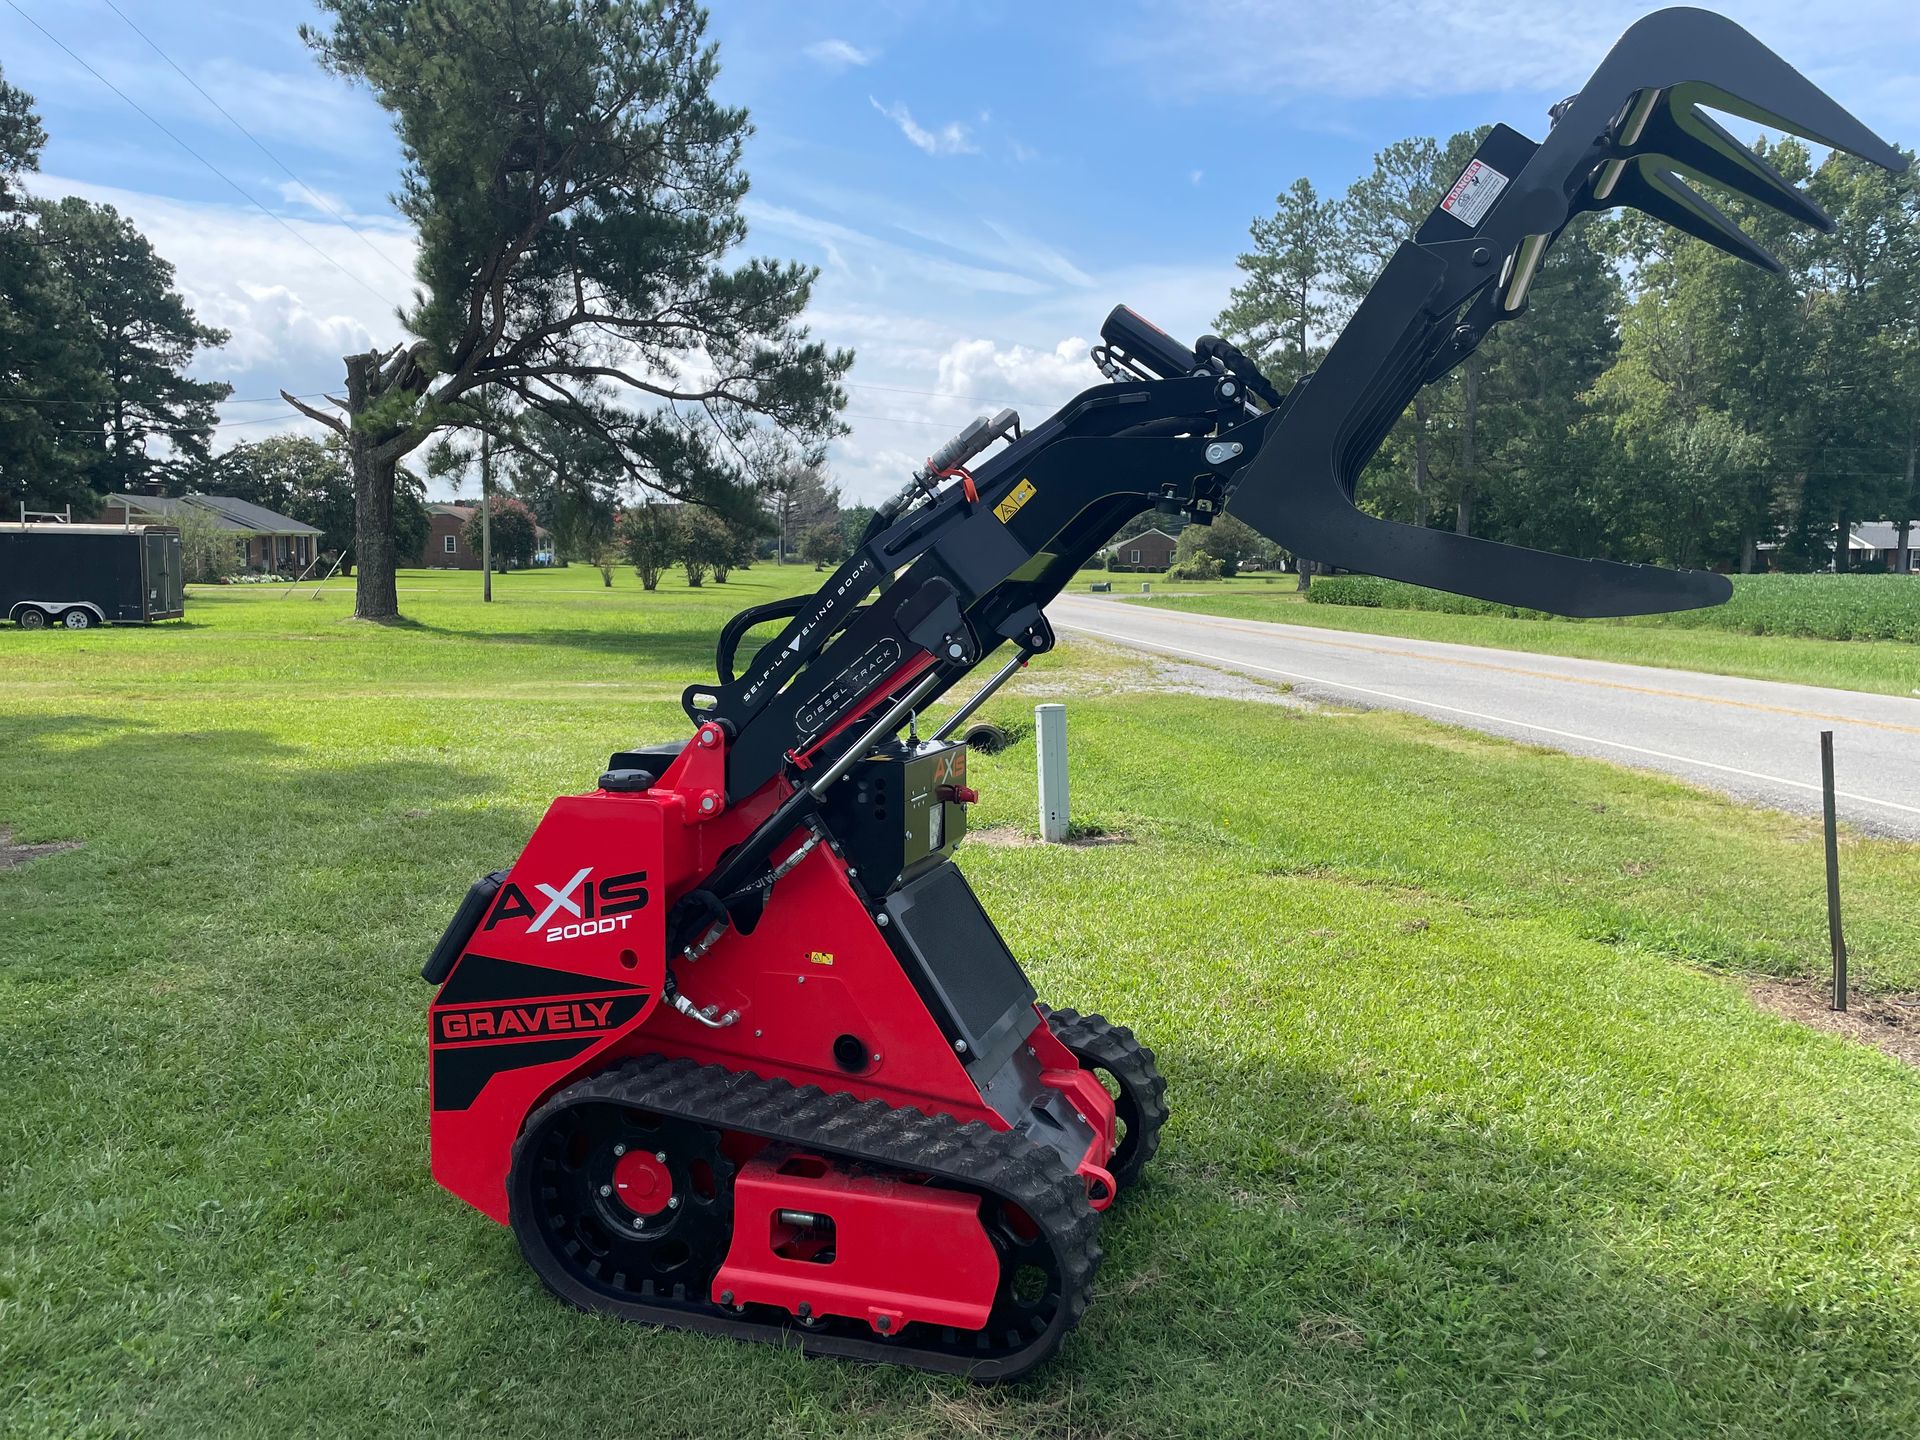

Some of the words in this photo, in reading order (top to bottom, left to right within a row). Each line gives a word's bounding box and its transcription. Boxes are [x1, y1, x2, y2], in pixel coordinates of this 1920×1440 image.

[1452, 164, 1480, 200] DANGER
[837, 560, 869, 596] BOOM
[805, 688, 848, 723] DIESEL
[852, 649, 891, 682] TRACK
[934, 751, 966, 785] AXIS
[482, 866, 649, 934] AXIS
[546, 914, 633, 943] 200DT
[441, 1001, 614, 1039] GRAVELY
